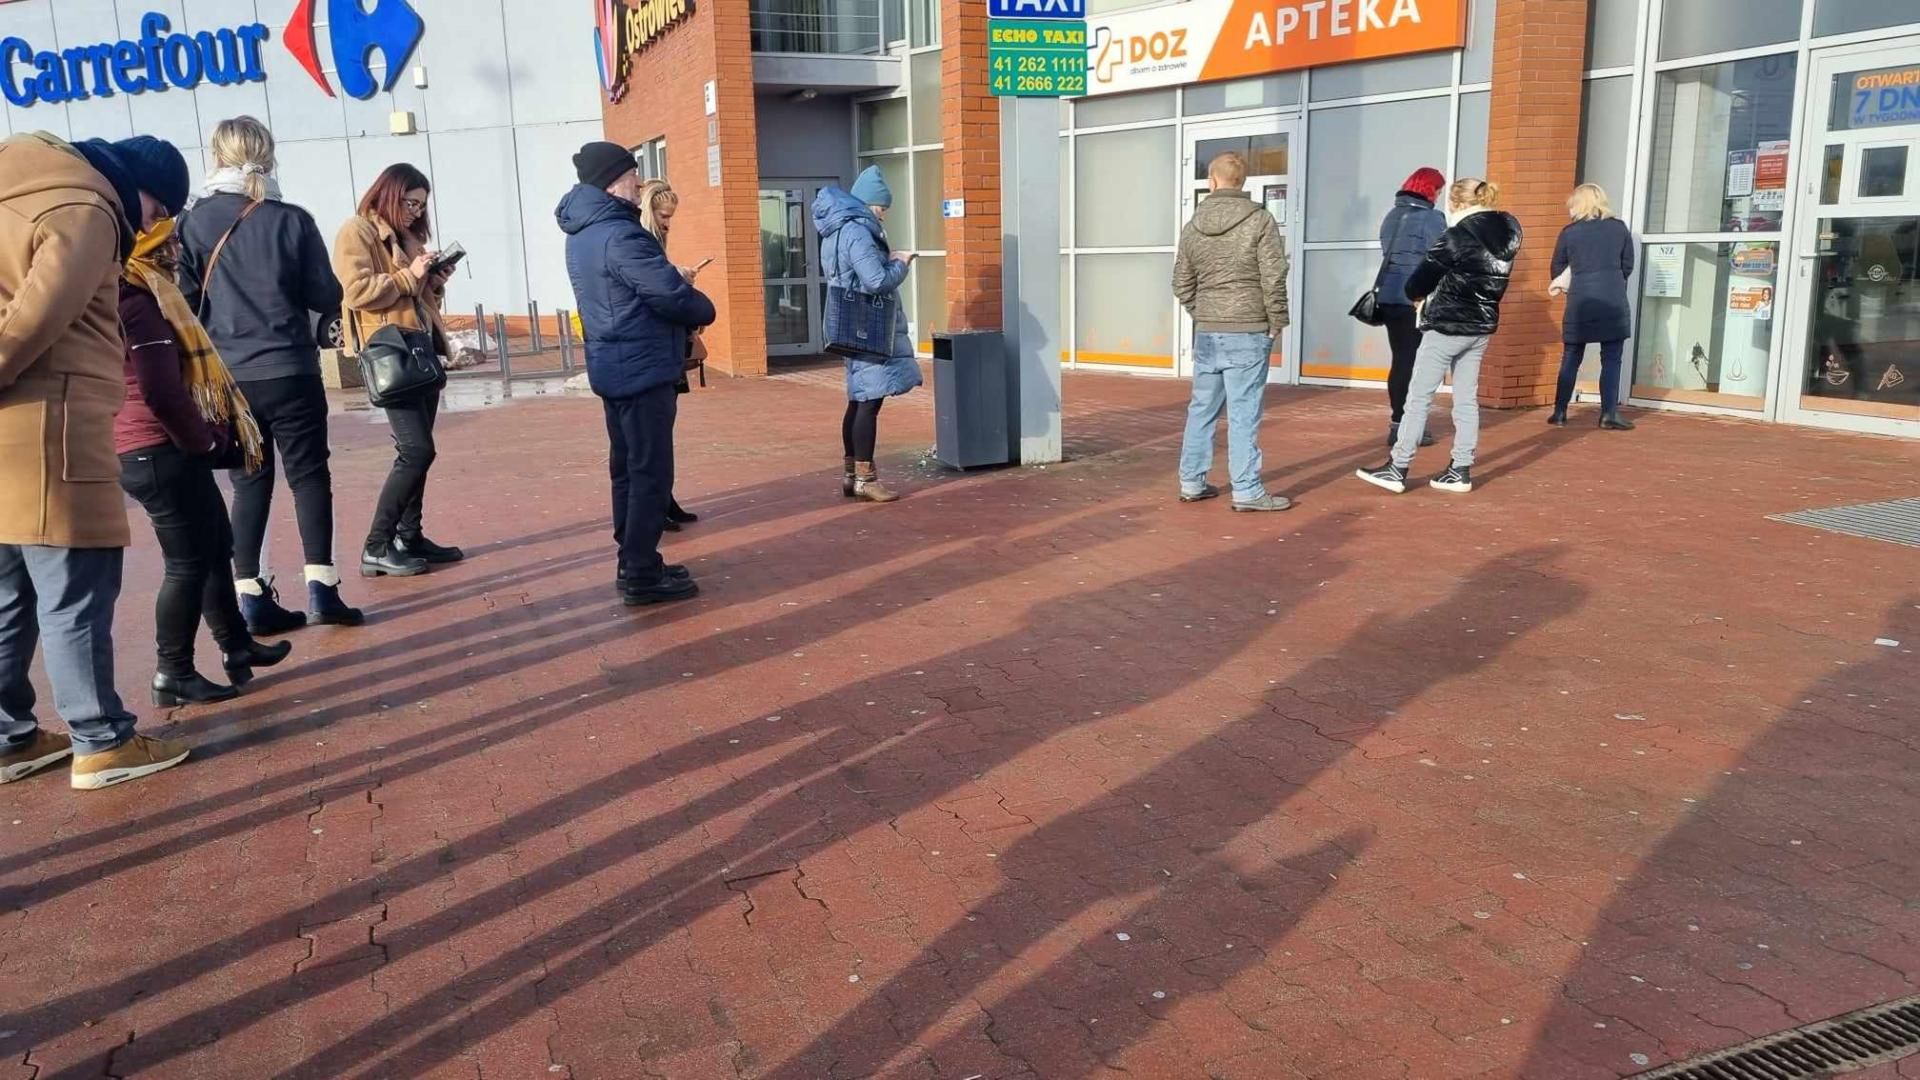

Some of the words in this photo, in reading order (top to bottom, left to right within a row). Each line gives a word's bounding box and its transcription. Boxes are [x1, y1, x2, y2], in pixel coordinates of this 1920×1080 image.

[1243, 0, 1422, 50] APTEKA
[992, 29, 1038, 43] ECHO
[1043, 30, 1085, 44] TAXI
[1130, 28, 1188, 64] DOZ
[0, 12, 268, 107] Carrefour
[994, 56, 1012, 72] 41
[1018, 56, 1046, 72] 262
[1051, 57, 1084, 73] 1111
[994, 76, 1011, 91] 41
[1017, 76, 1053, 91] 2666
[1057, 76, 1084, 91] 222
[1856, 90, 1872, 112] 7
